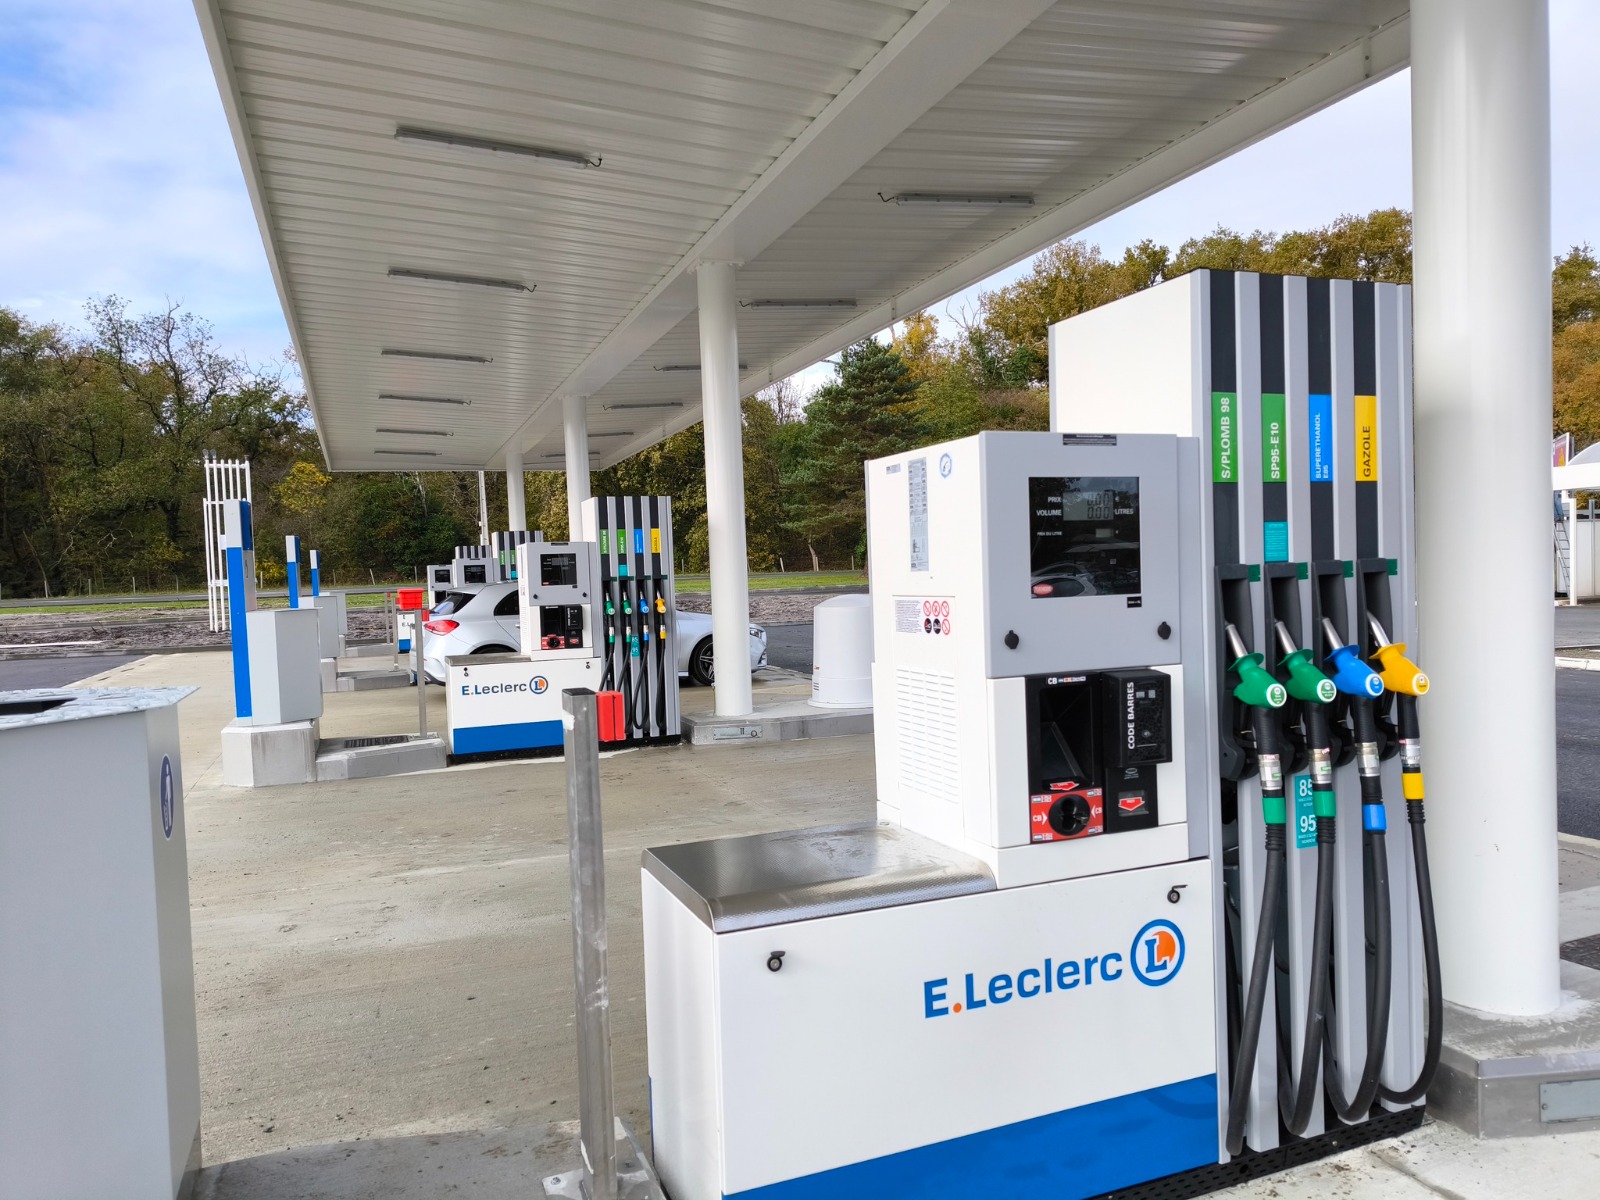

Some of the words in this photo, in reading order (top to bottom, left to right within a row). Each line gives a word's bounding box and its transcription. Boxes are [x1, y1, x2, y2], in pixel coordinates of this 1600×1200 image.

[1220, 397, 1230, 413] 98
[1221, 416, 1231, 479] S/PLOMB
[1270, 422, 1280, 479] SP95-E10
[1314, 412, 1322, 479] SUPERETHANOL
[1362, 425, 1371, 478] GAZOLE
[461, 682, 527, 696] E.Leclerc
[1047, 677, 1057, 685] CB
[1126, 682, 1134, 720] BARRES
[1127, 722, 1135, 750] CODE
[1300, 814, 1317, 833] 95
[923, 952, 1123, 1019] E.Leclerc
